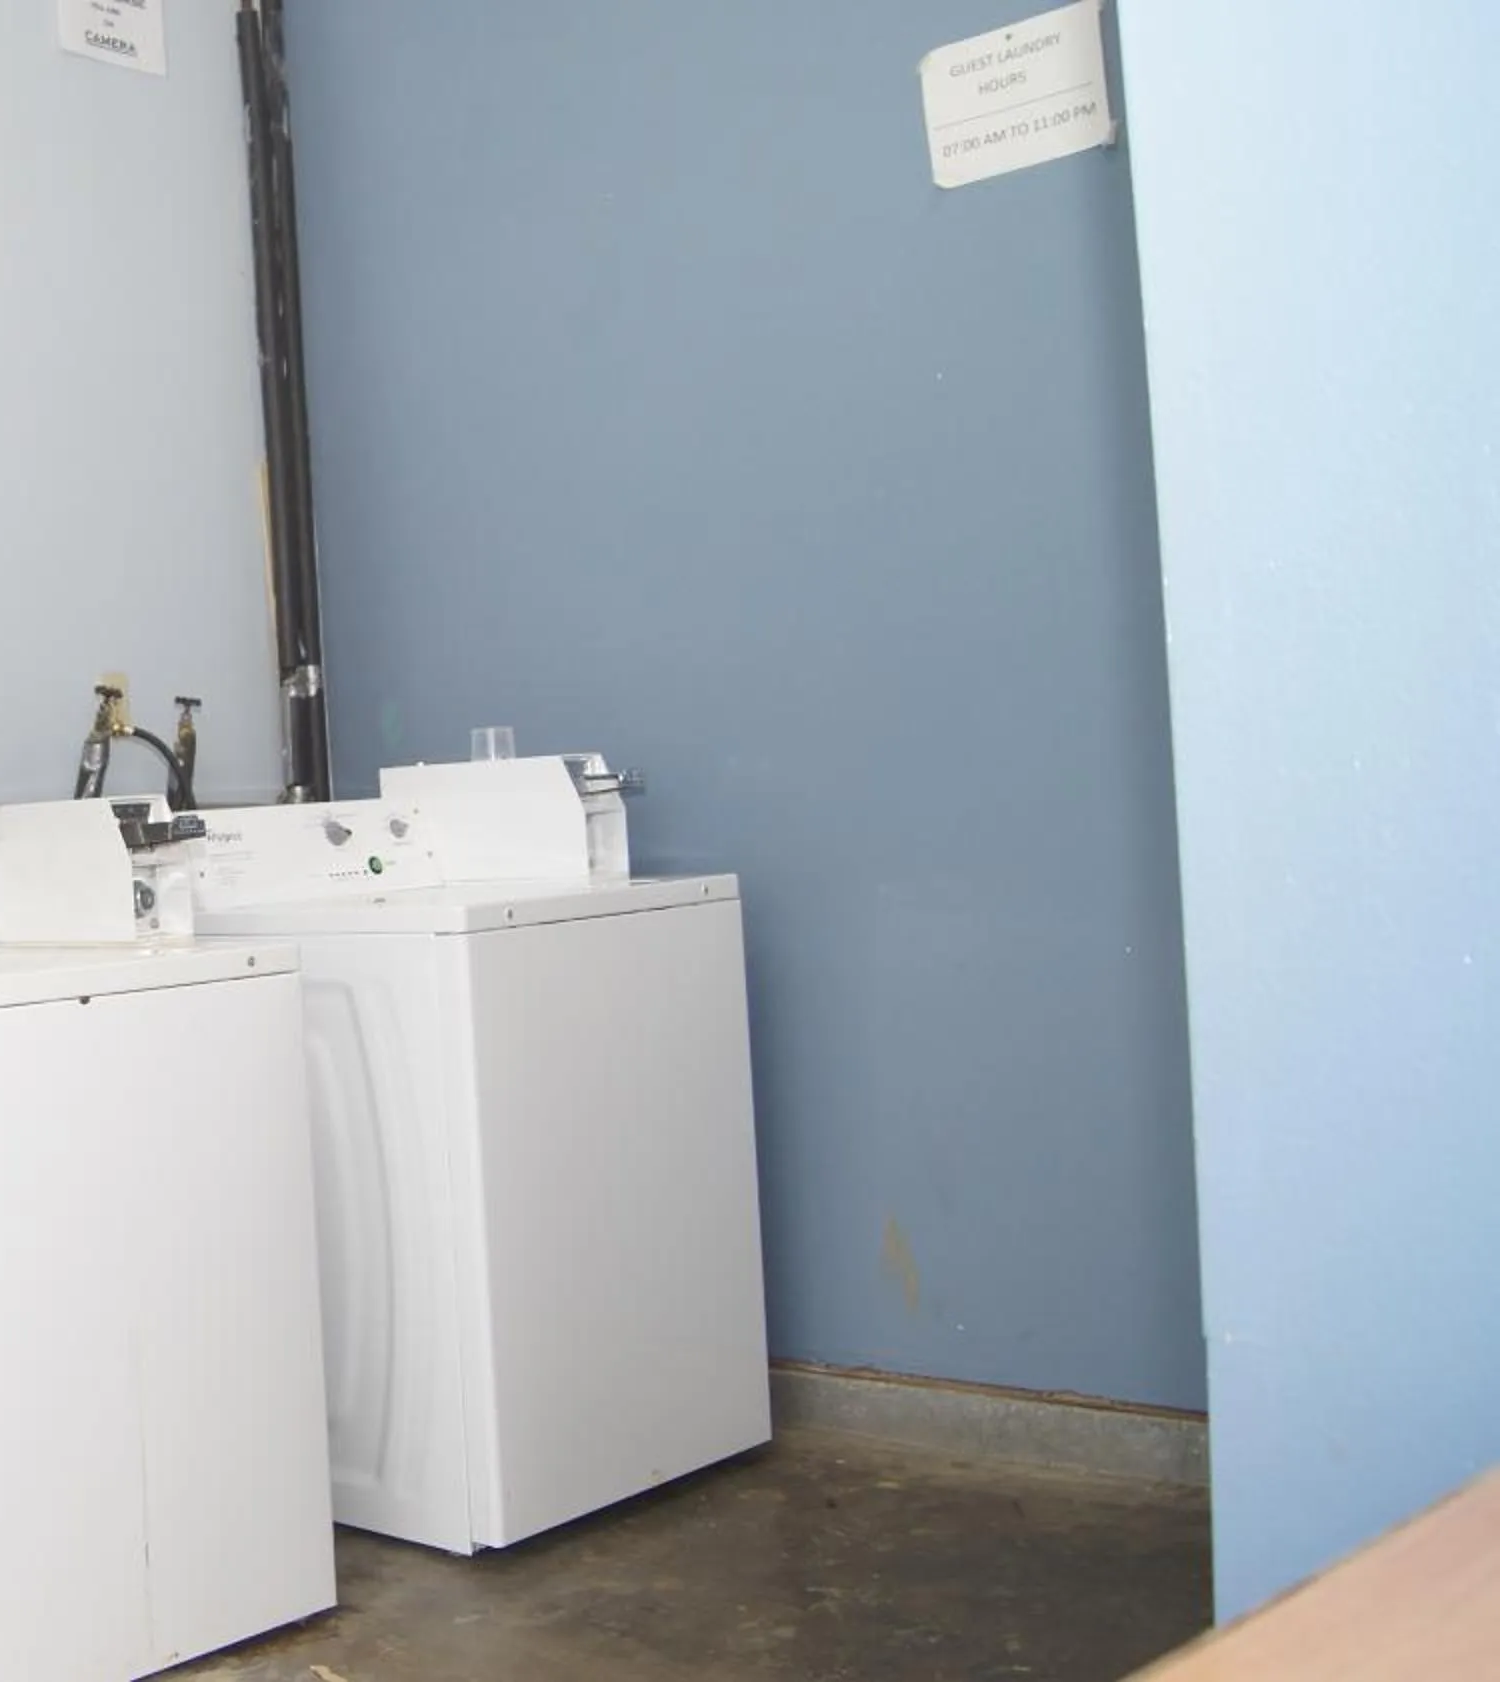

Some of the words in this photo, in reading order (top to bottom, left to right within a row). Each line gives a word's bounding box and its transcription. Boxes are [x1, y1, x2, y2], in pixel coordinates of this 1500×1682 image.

[949, 53, 993, 77] GUEST
[997, 32, 1061, 63] LAUNDRY
[978, 71, 1027, 95] HOURS
[984, 130, 1007, 145] AM
[1010, 123, 1029, 138] TO
[1073, 101, 1097, 120] PM
